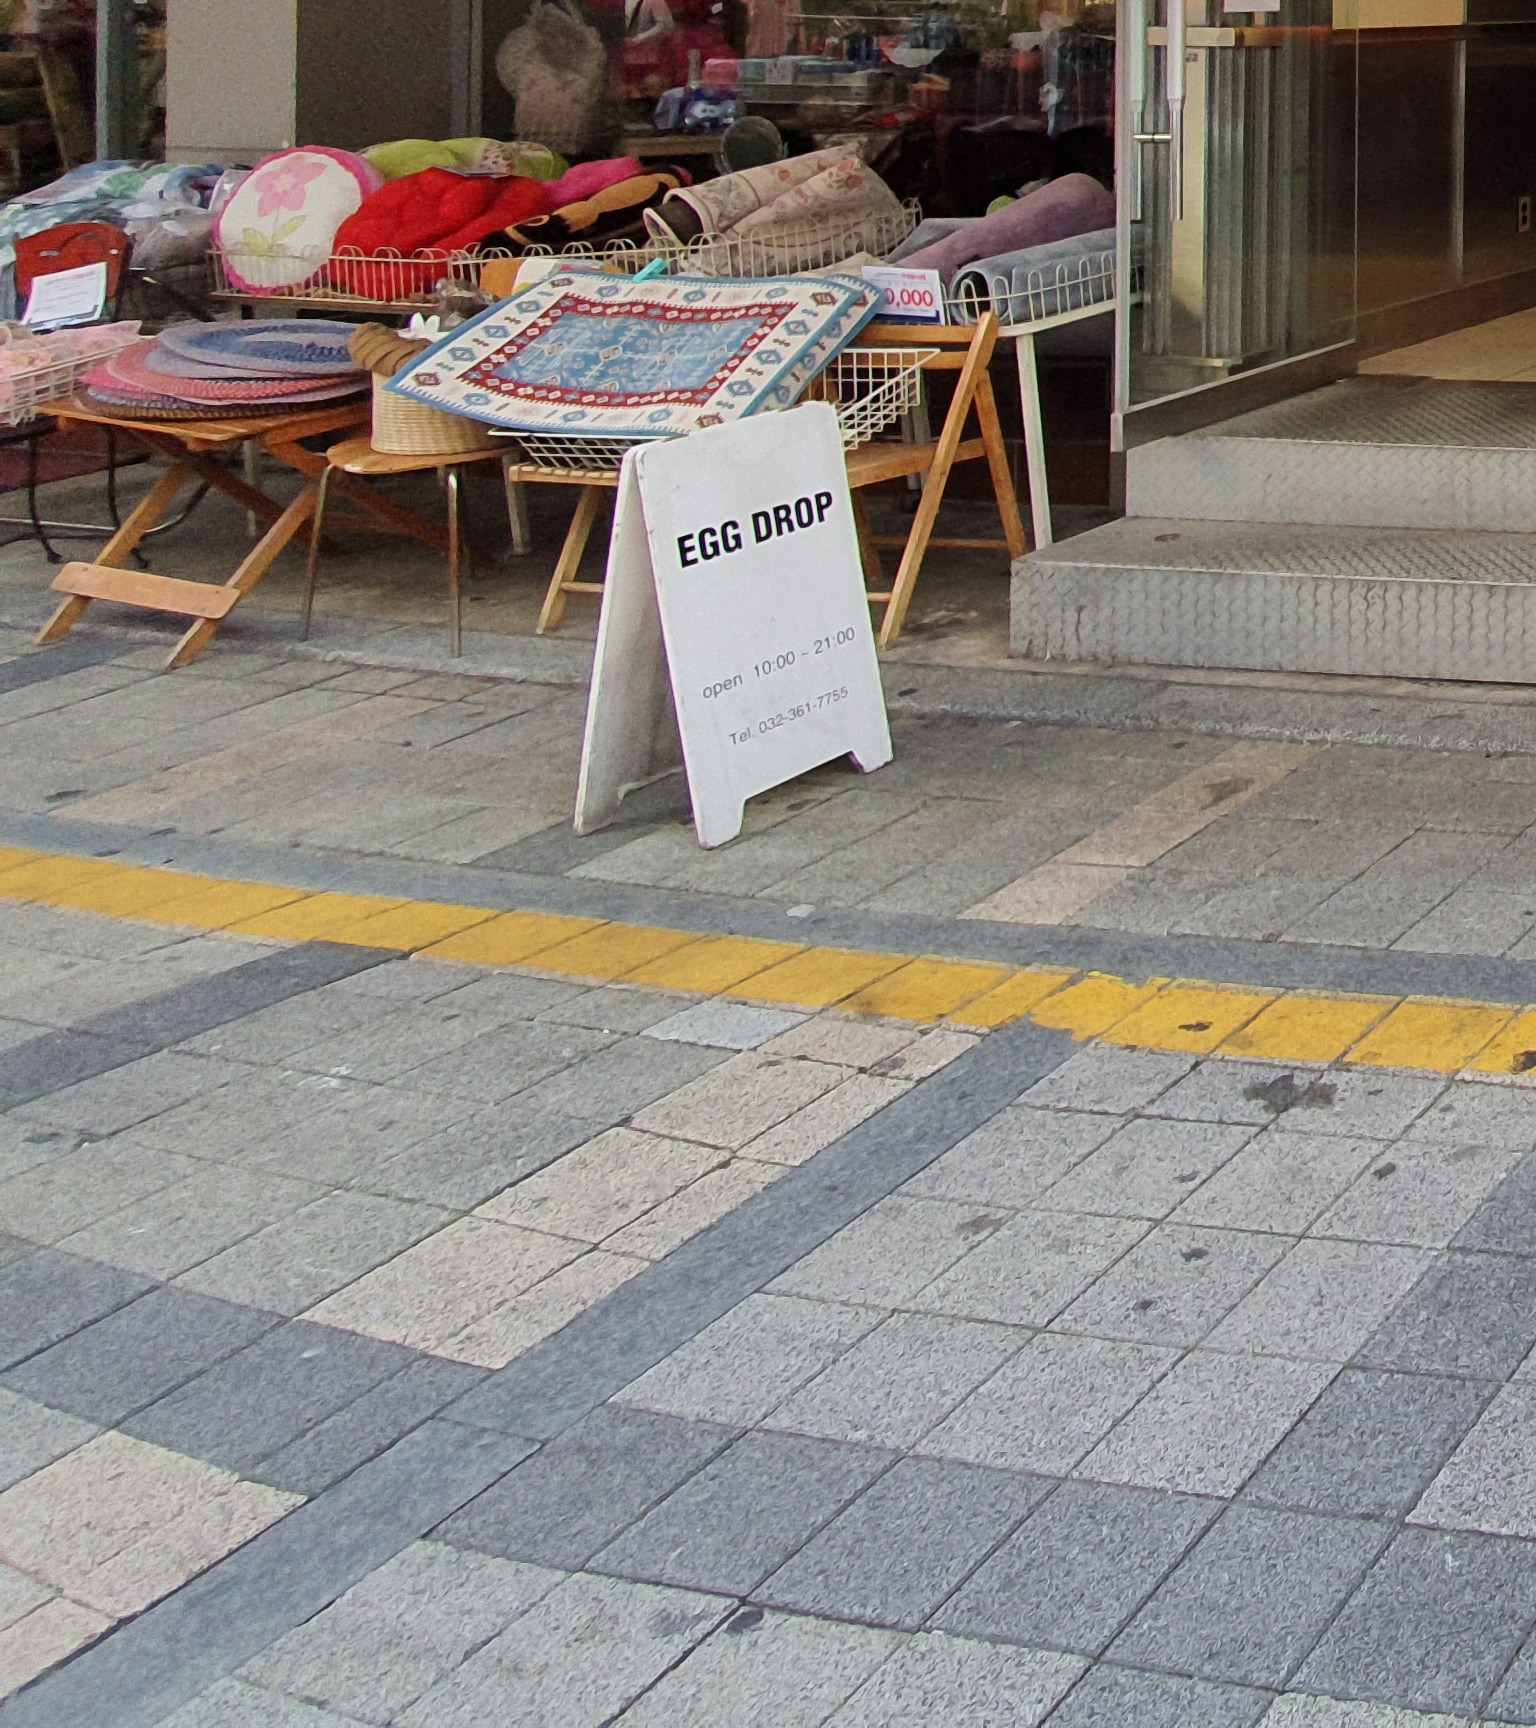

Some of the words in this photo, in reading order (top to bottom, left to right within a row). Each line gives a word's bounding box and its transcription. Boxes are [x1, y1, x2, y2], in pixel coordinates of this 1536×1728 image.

[677, 520, 743, 568] EGG
[751, 491, 833, 544] DROP
[702, 673, 744, 700] open
[753, 649, 796, 679] 10:00
[813, 626, 856, 656] 21:00
[758, 685, 849, 734] 032-361-7755
